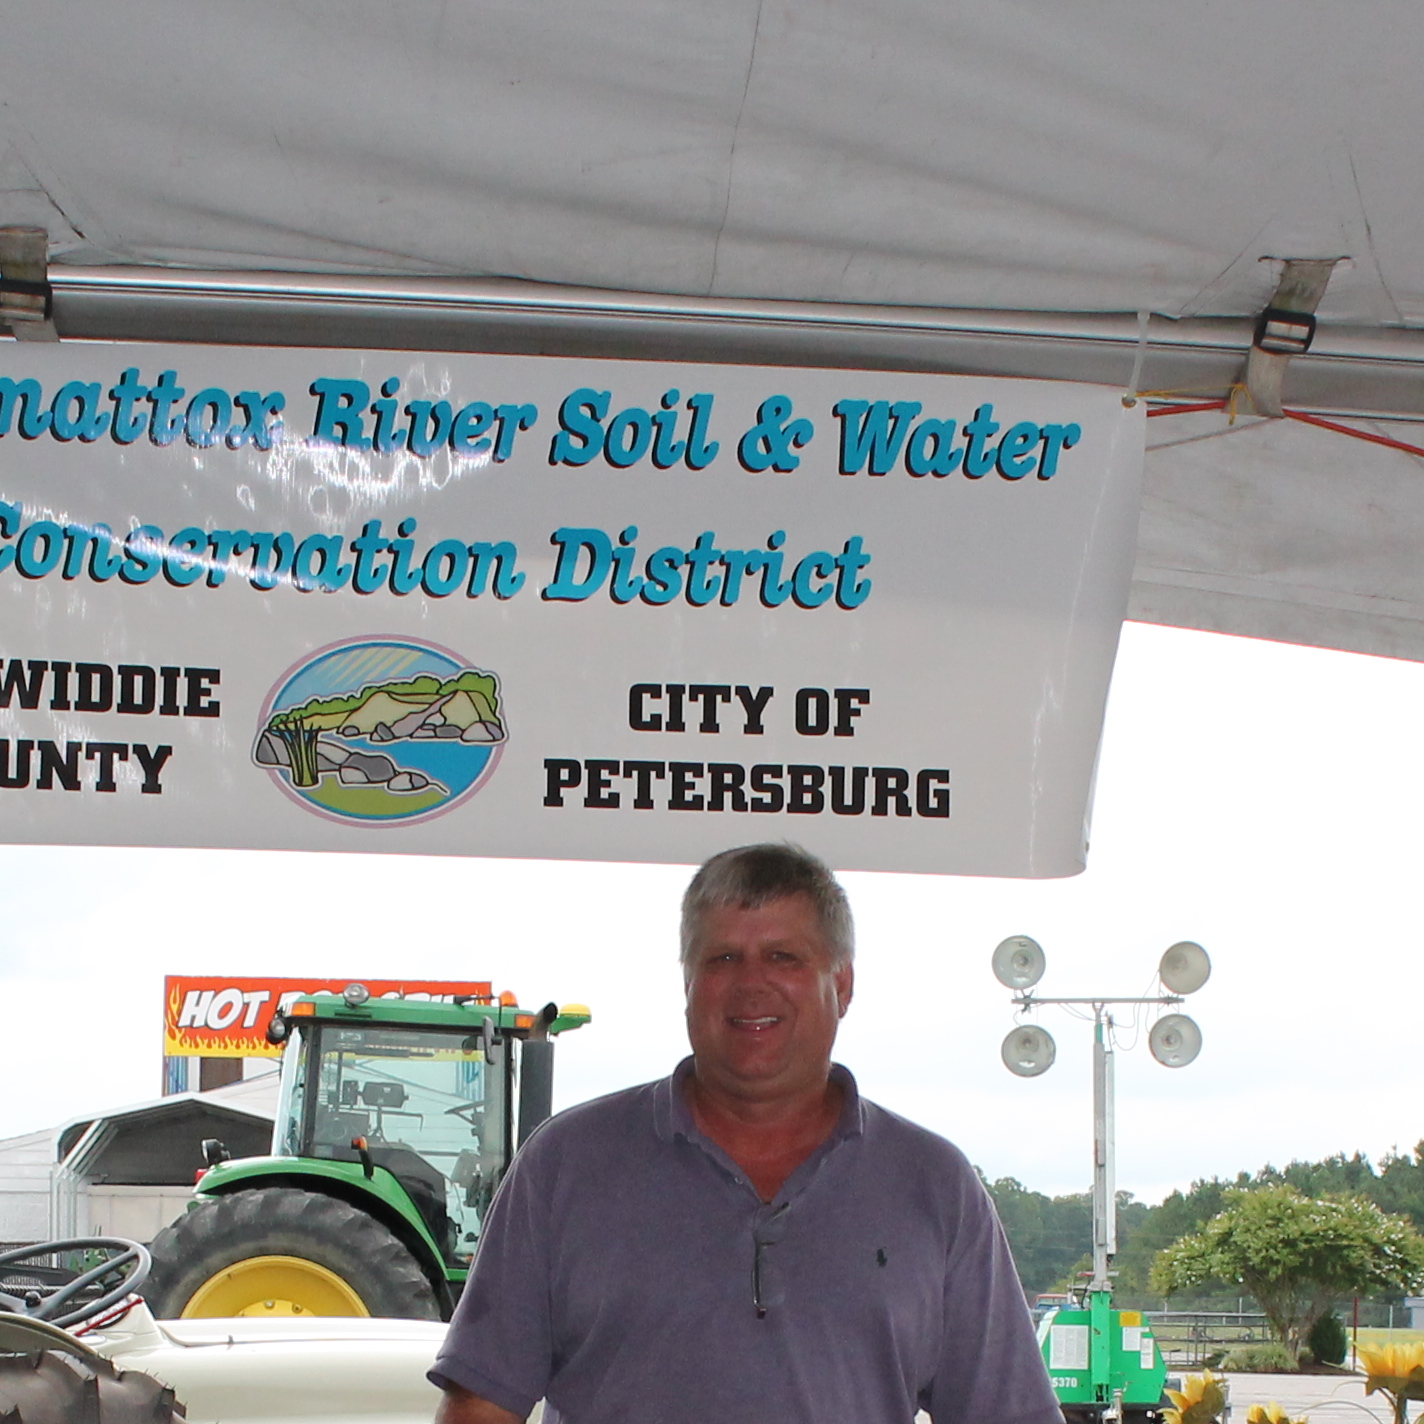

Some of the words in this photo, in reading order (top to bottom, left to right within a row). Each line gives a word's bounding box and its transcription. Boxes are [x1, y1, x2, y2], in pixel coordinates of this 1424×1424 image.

[309, 376, 535, 468] River
[549, 388, 719, 472] Soil
[737, 396, 814, 476] &
[836, 397, 1081, 482] Water
[541, 526, 873, 609] District
[628, 684, 774, 734] CITY
[794, 688, 871, 737] OF
[543, 761, 951, 819] PETERSBURG
[178, 988, 270, 1031] HOT
